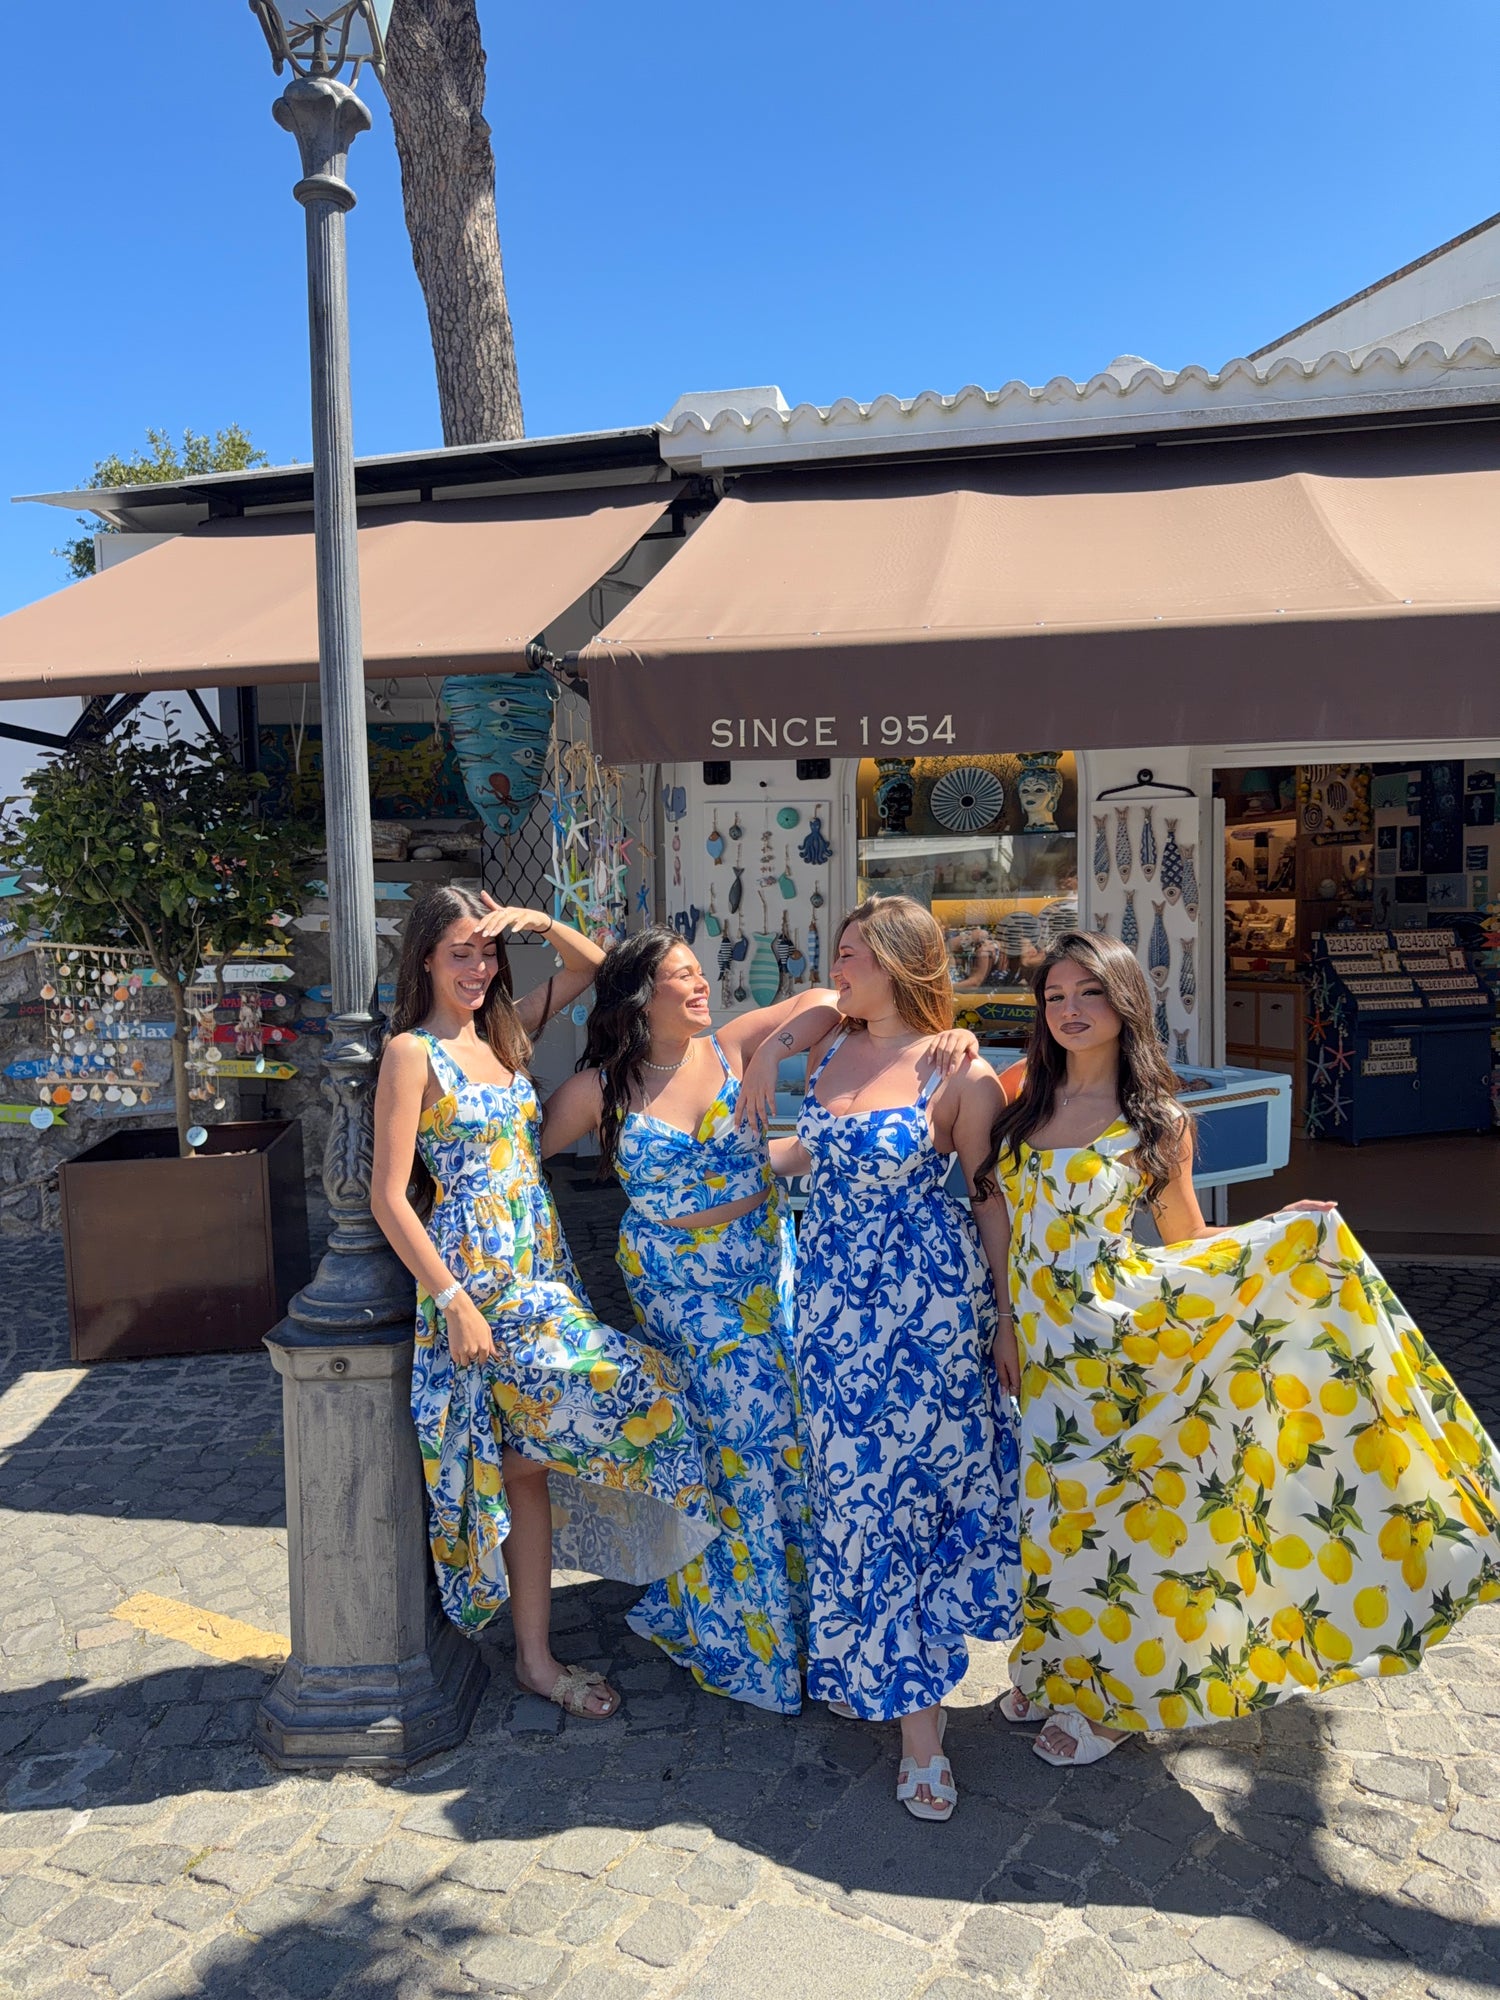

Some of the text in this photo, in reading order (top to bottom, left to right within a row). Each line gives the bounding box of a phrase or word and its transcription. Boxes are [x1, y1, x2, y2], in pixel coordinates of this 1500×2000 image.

[711, 714, 956, 748] SINCE 1954
[1001, 1007, 1036, 1018] J'ADOR
[117, 1024, 169, 1038] Relax
